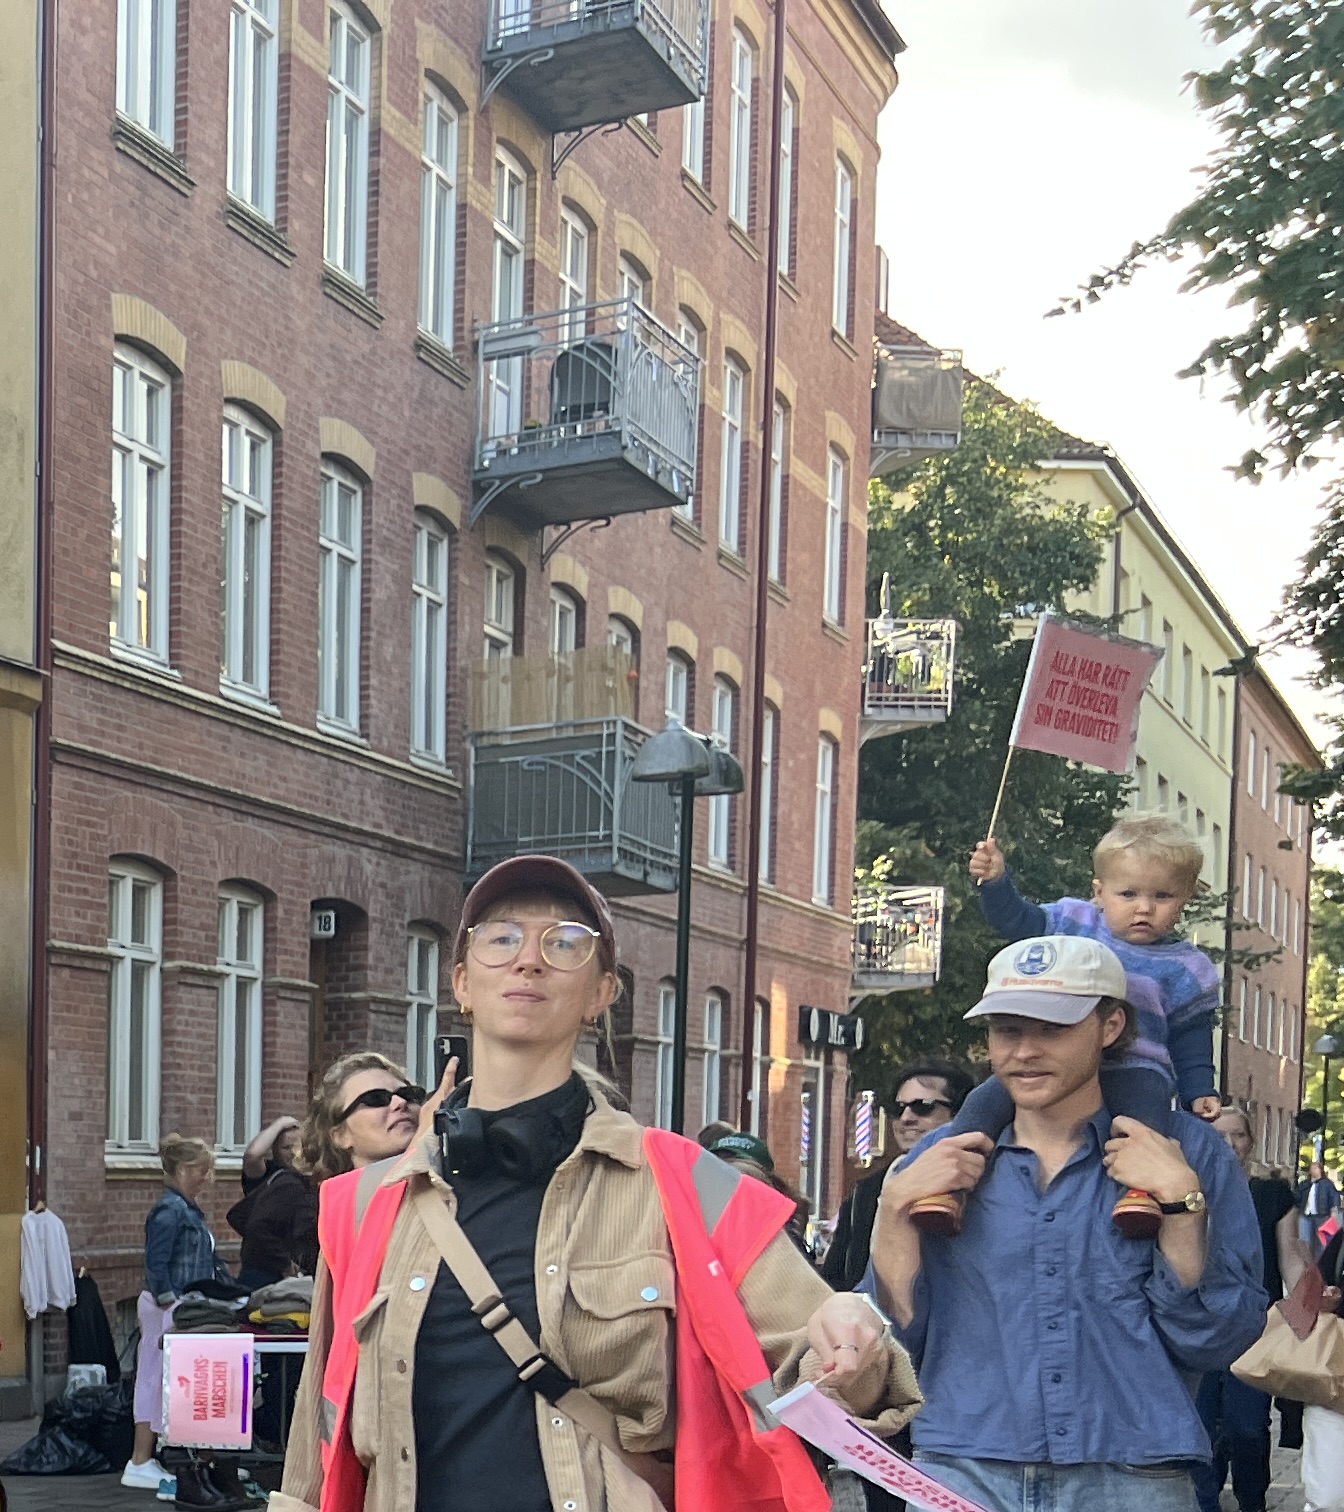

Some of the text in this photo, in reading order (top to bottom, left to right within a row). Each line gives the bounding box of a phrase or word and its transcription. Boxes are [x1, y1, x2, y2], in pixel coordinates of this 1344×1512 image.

[1049, 650, 1077, 678] ALLA
[1076, 658, 1102, 684] HAR
[316, 914, 332, 932] 18
